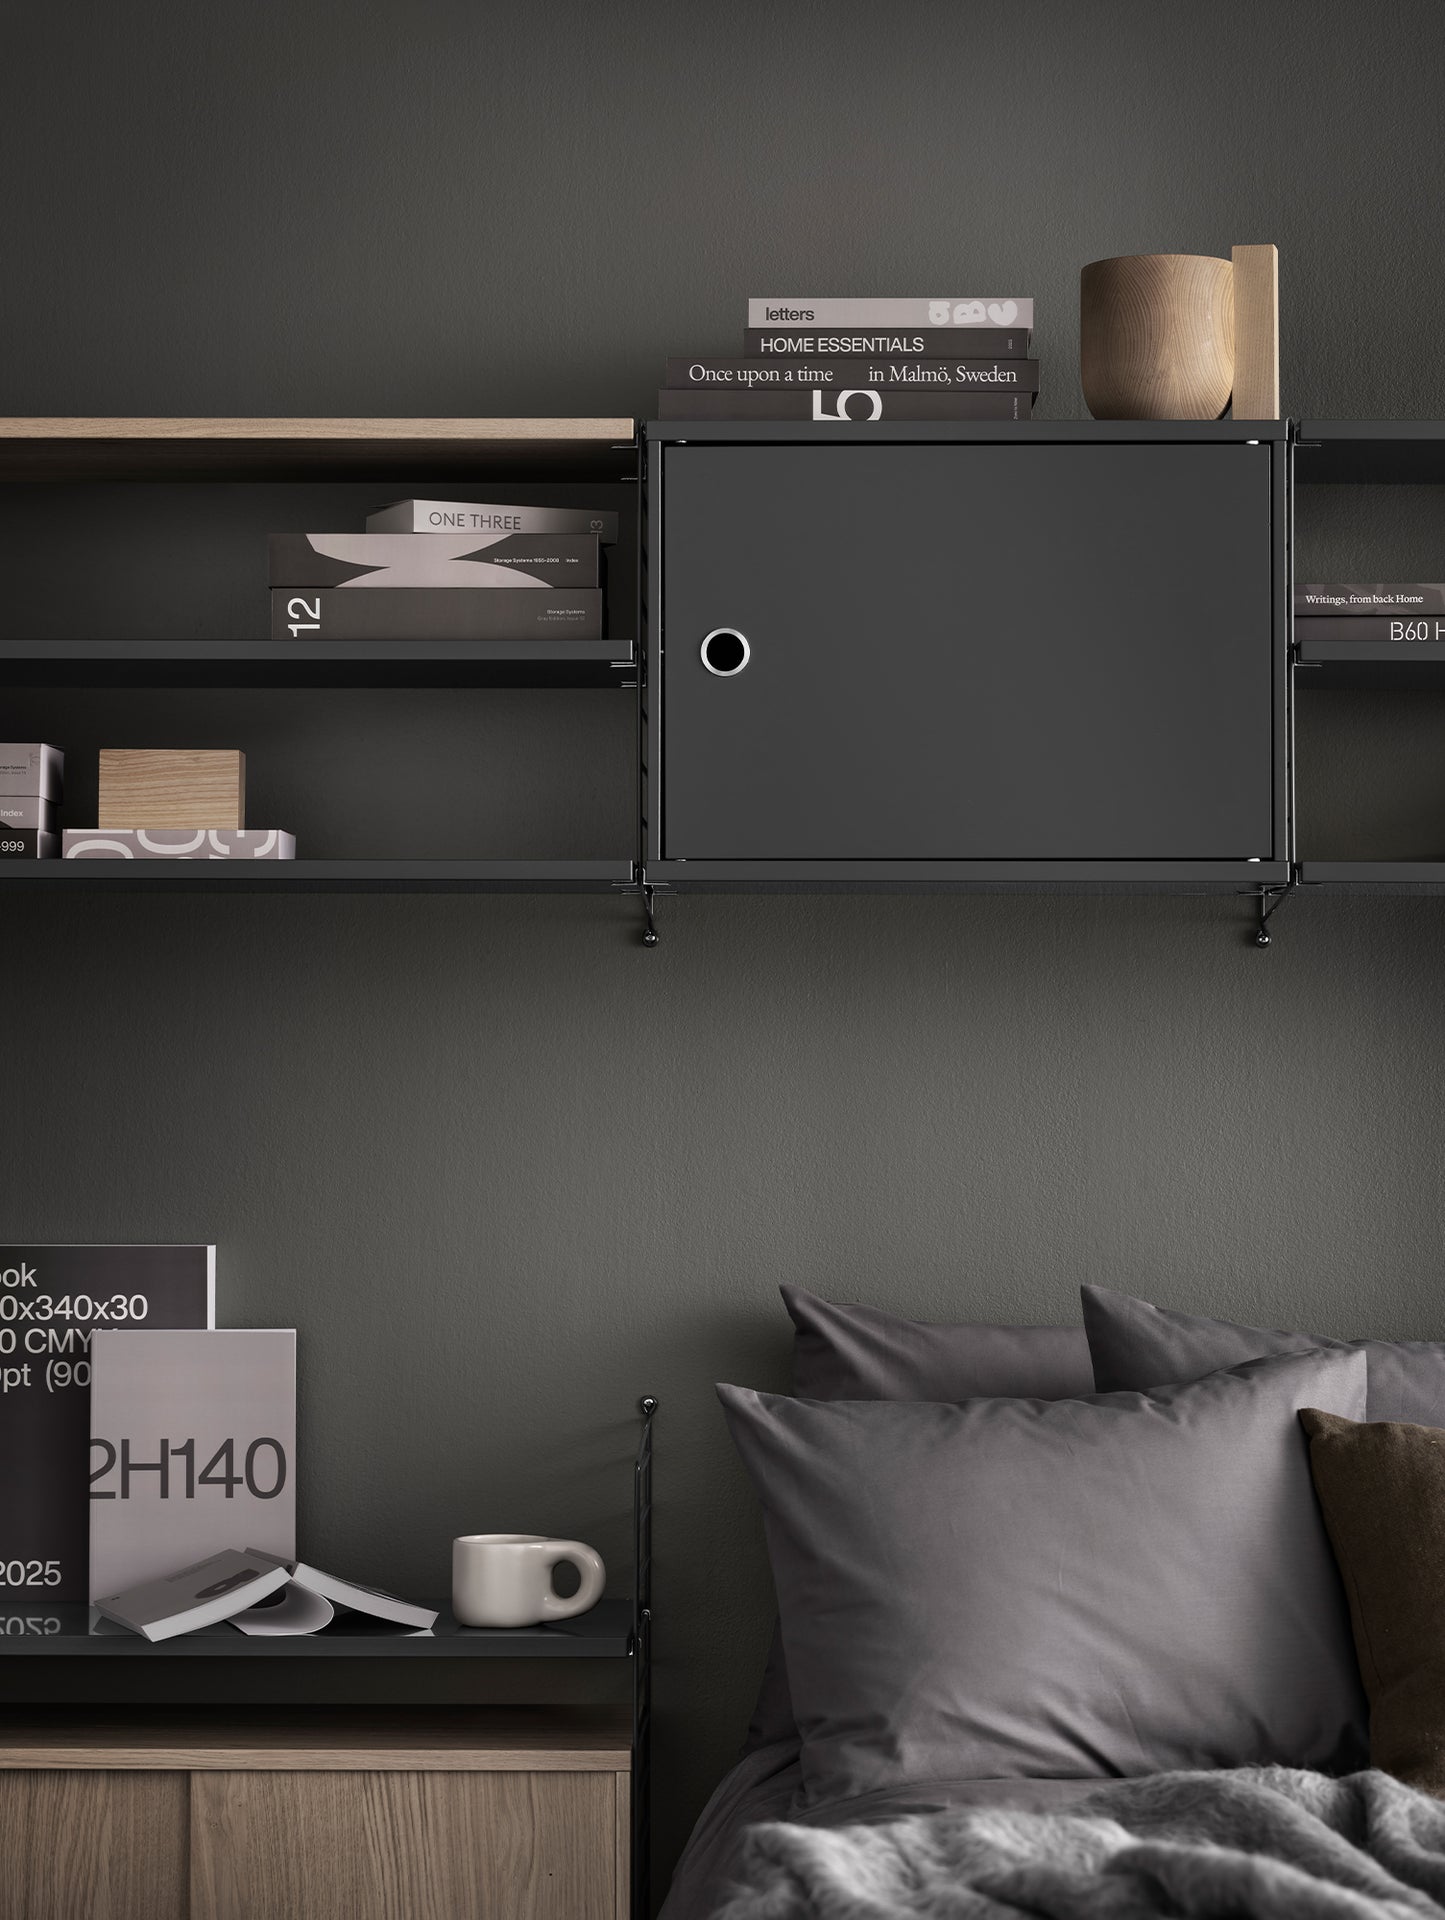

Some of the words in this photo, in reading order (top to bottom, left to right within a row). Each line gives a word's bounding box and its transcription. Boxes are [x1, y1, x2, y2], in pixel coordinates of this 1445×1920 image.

[765, 306, 815, 321] letters
[760, 338, 814, 353] HOME
[817, 337, 924, 353] ESSENTIALS
[689, 364, 733, 382] Once
[737, 370, 781, 388] upon
[784, 370, 794, 382] a
[797, 366, 834, 382] time
[868, 366, 885, 382] in
[889, 364, 952, 386] Malmö,
[955, 365, 1018, 383] Sweden
[429, 511, 466, 528] ONE
[469, 514, 522, 530] THREE
[1305, 595, 1349, 606] Writings,
[1349, 594, 1373, 604] from
[1373, 594, 1394, 604] back
[1395, 594, 1424, 604] Home
[287, 597, 321, 638] 12
[1390, 621, 1428, 641] B60
[1, 809, 24, 817] Index
[0, 1262, 38, 1288] ok
[24, 1327, 119, 1354] CMY
[0, 1363, 32, 1393] pt
[90, 1437, 287, 1500] 2H140
